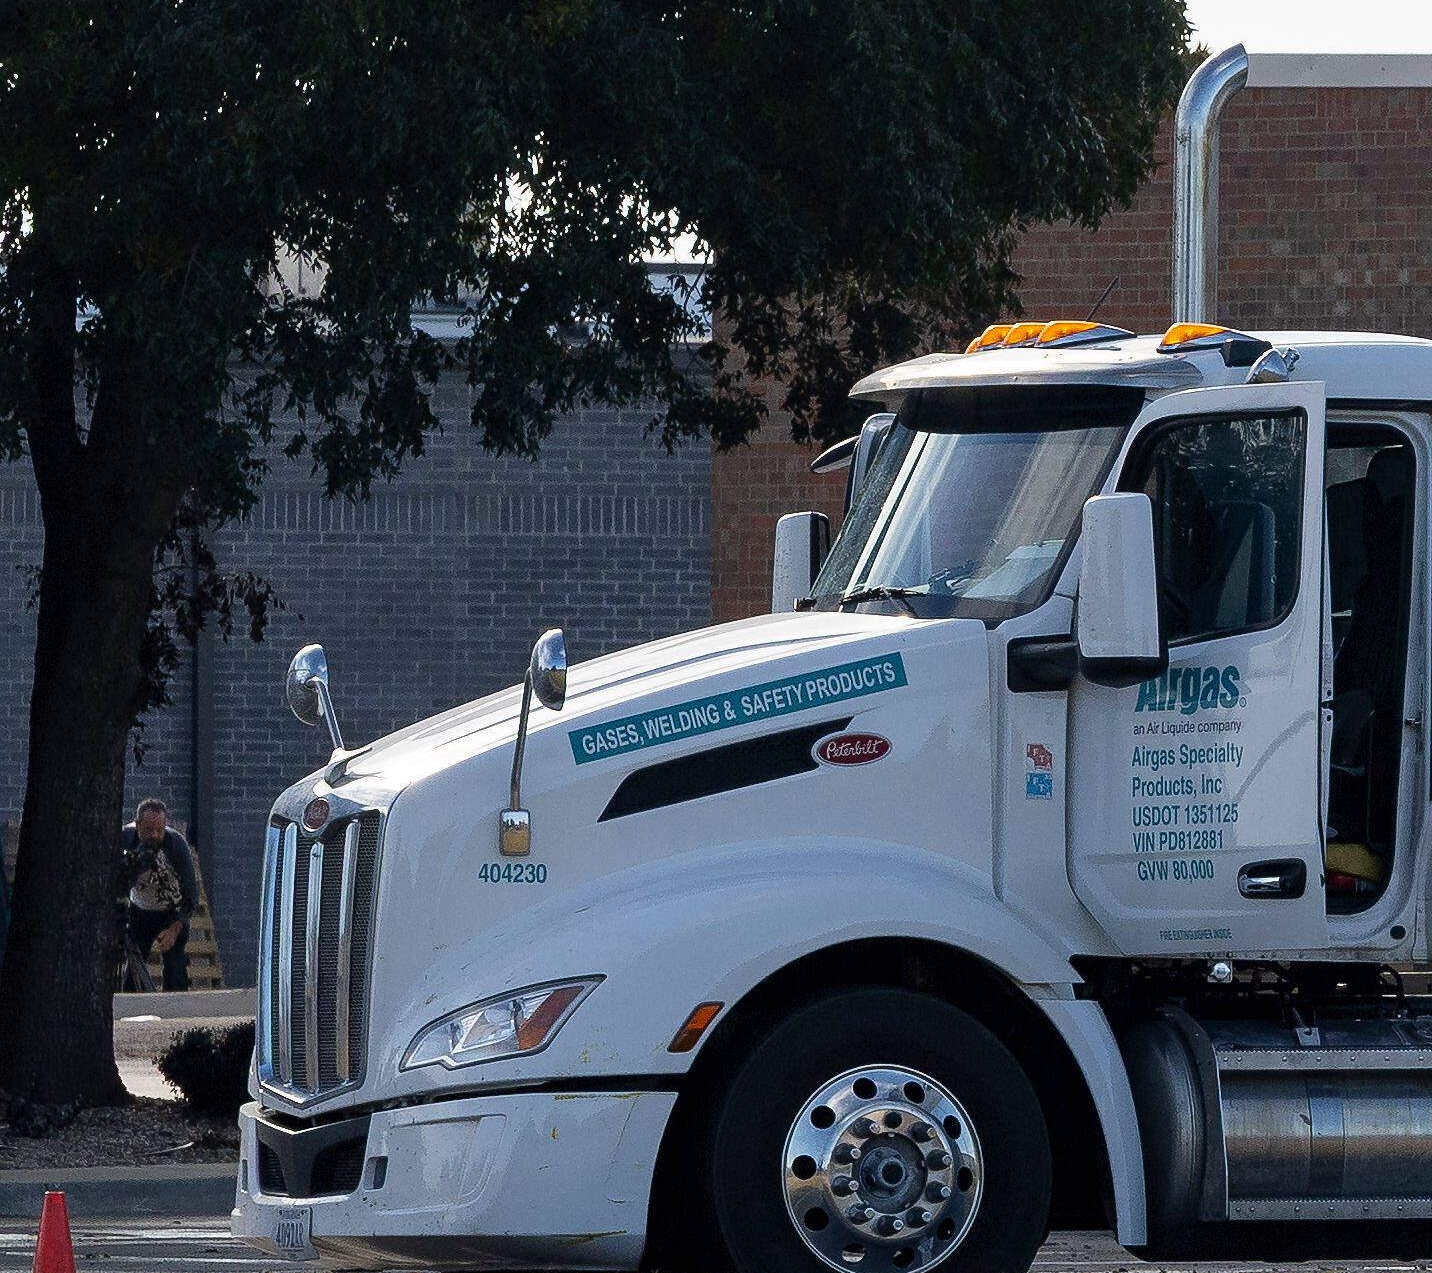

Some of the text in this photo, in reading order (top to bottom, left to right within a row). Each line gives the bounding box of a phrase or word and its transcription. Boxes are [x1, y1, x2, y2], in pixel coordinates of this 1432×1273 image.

[582, 662, 896, 755] GASES, WELDING & SAFETY PRODUCTS
[1133, 721, 1242, 737] an Air Liquide company
[826, 737, 884, 758] Peterbilt
[1132, 742, 1243, 771] Airgas Specialty
[1132, 774, 1222, 798] Products, Inc
[1132, 803, 1239, 826] USDOT 1351125
[1132, 829, 1223, 852] VIN PD812881
[478, 863, 548, 883] 404230
[1137, 859, 1214, 882] GVW 80,000
